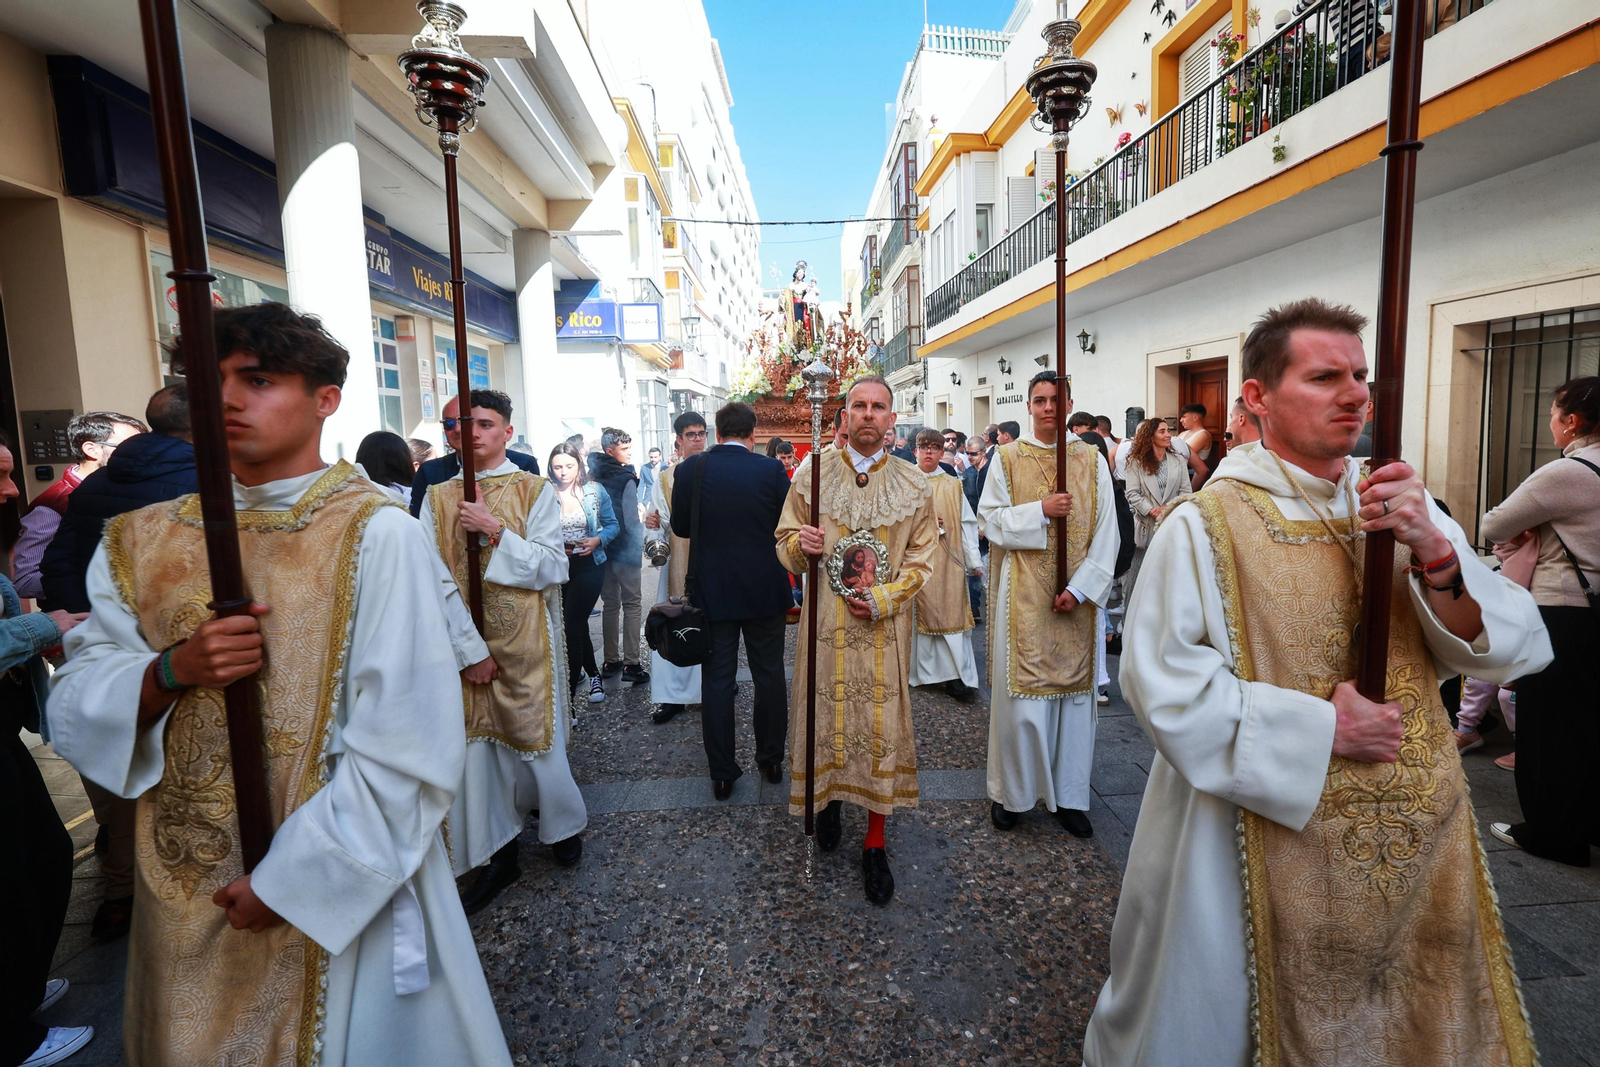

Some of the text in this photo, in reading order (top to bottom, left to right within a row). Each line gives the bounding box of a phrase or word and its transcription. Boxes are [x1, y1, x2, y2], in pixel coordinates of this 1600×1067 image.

[367, 240, 389, 256] GRUPO
[412, 265, 453, 302] Viajes Ri
[569, 310, 602, 328] Rico
[1185, 347, 1192, 361] 5
[1004, 382, 1014, 391] BAR
